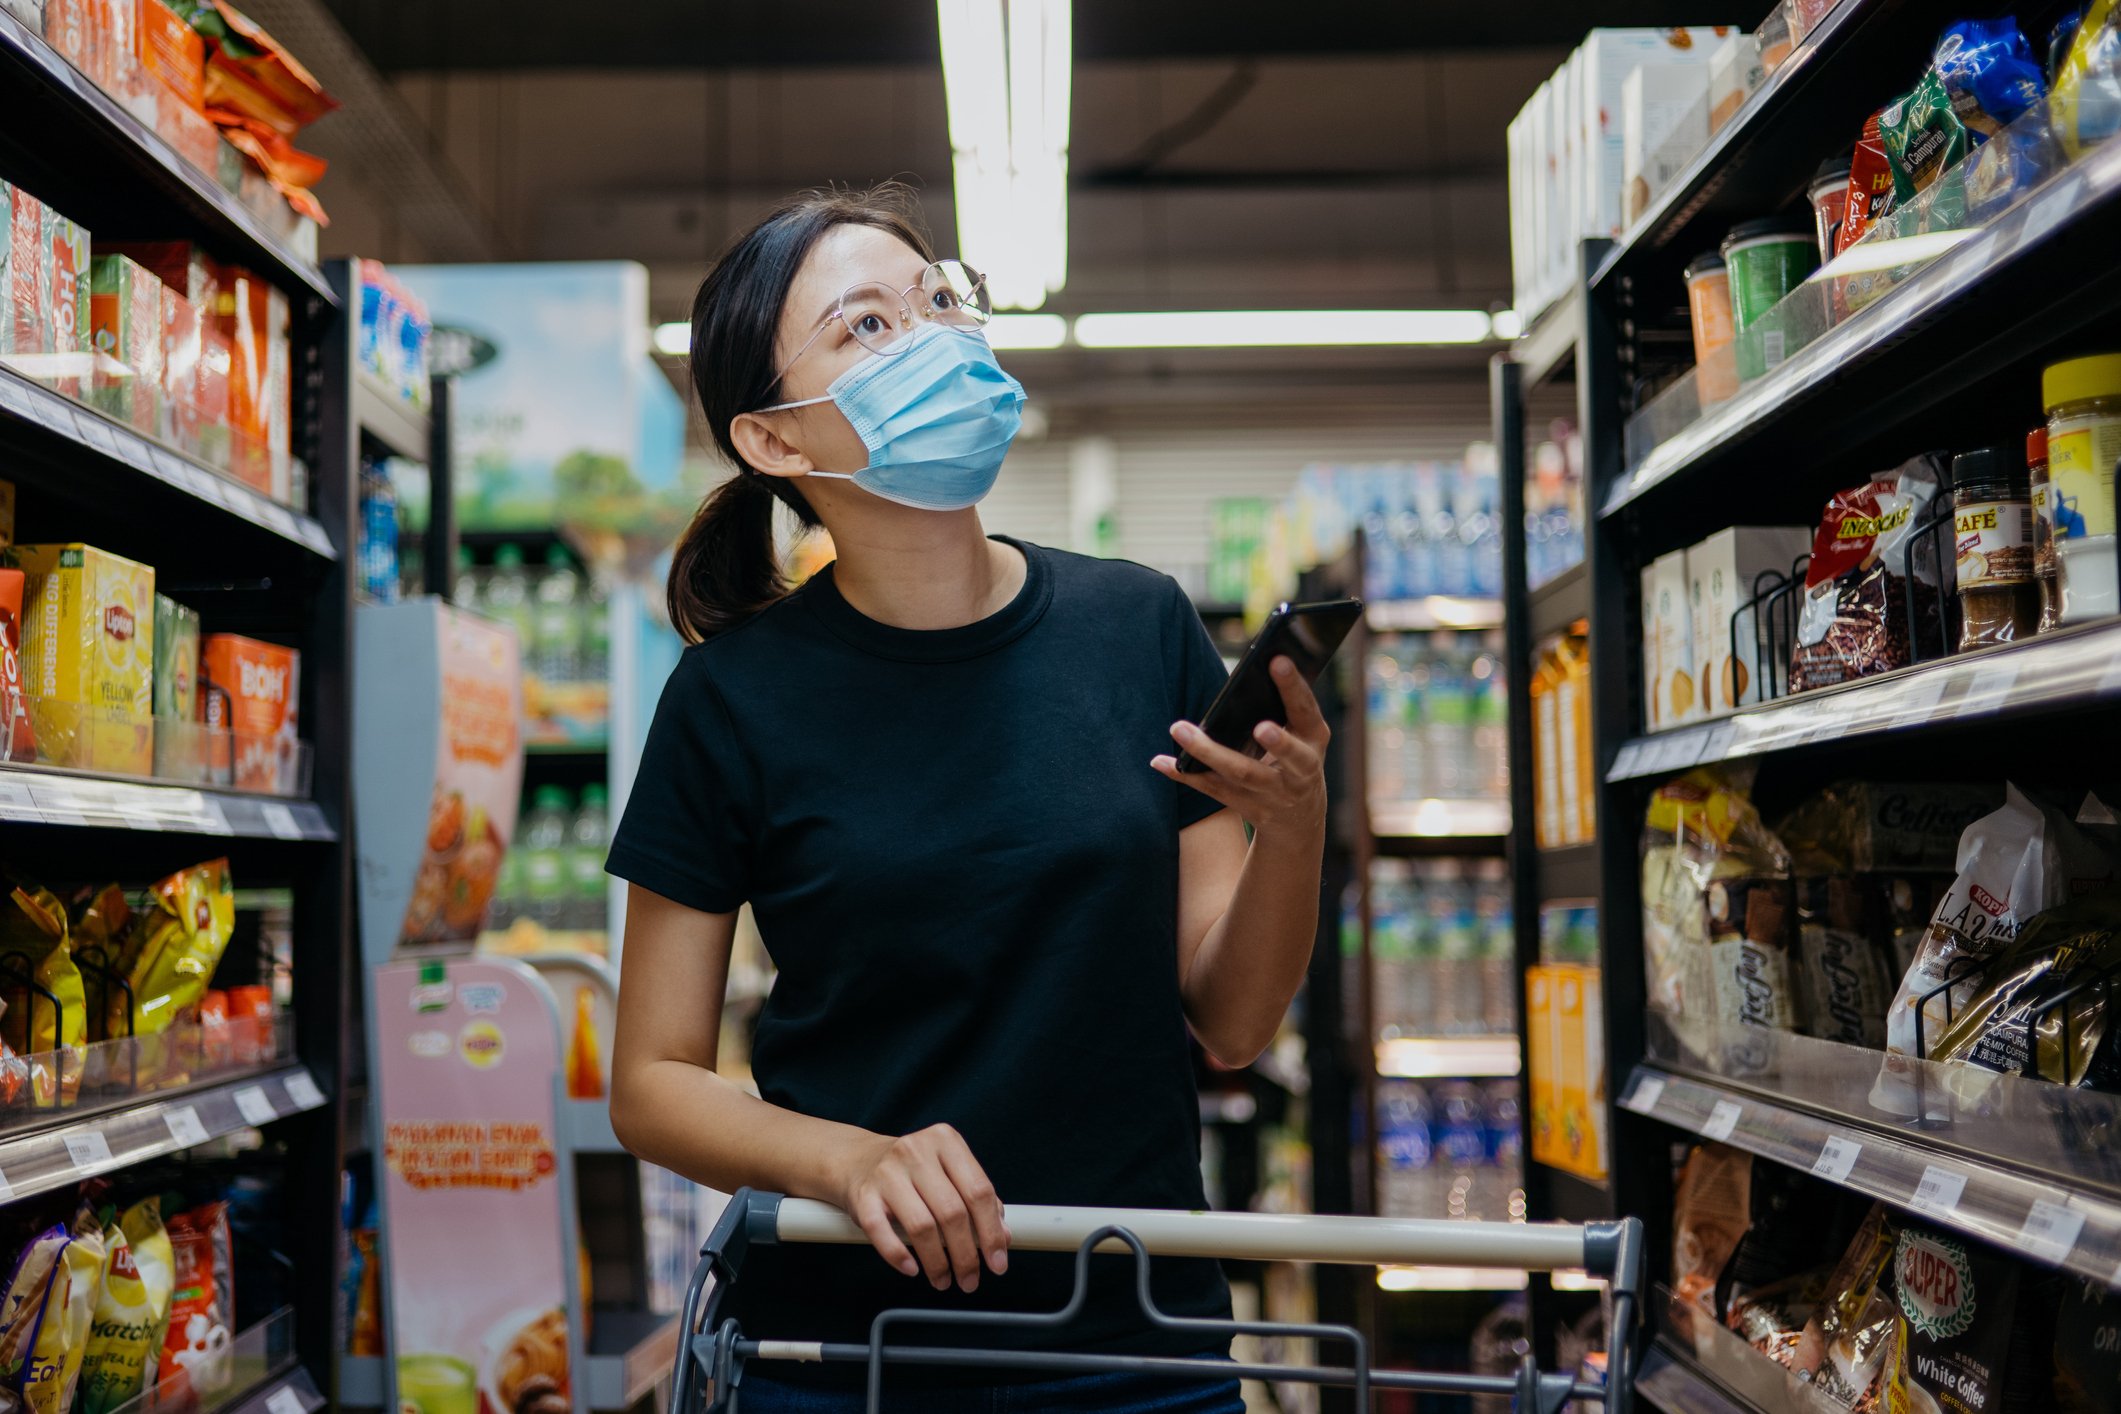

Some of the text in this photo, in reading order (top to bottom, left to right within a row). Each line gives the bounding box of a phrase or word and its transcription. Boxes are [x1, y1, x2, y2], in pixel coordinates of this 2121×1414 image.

[1908, 130, 1948, 168] Campuran
[43, 573, 59, 697] BIG DIFFERENCE
[104, 607, 134, 635] Lipton
[101, 681, 134, 704] YELLOW
[241, 660, 284, 703] BOH
[1904, 1246, 1957, 1308] SUPER
[1917, 1354, 1956, 1388] White
[1957, 1375, 1985, 1409] Coffee
